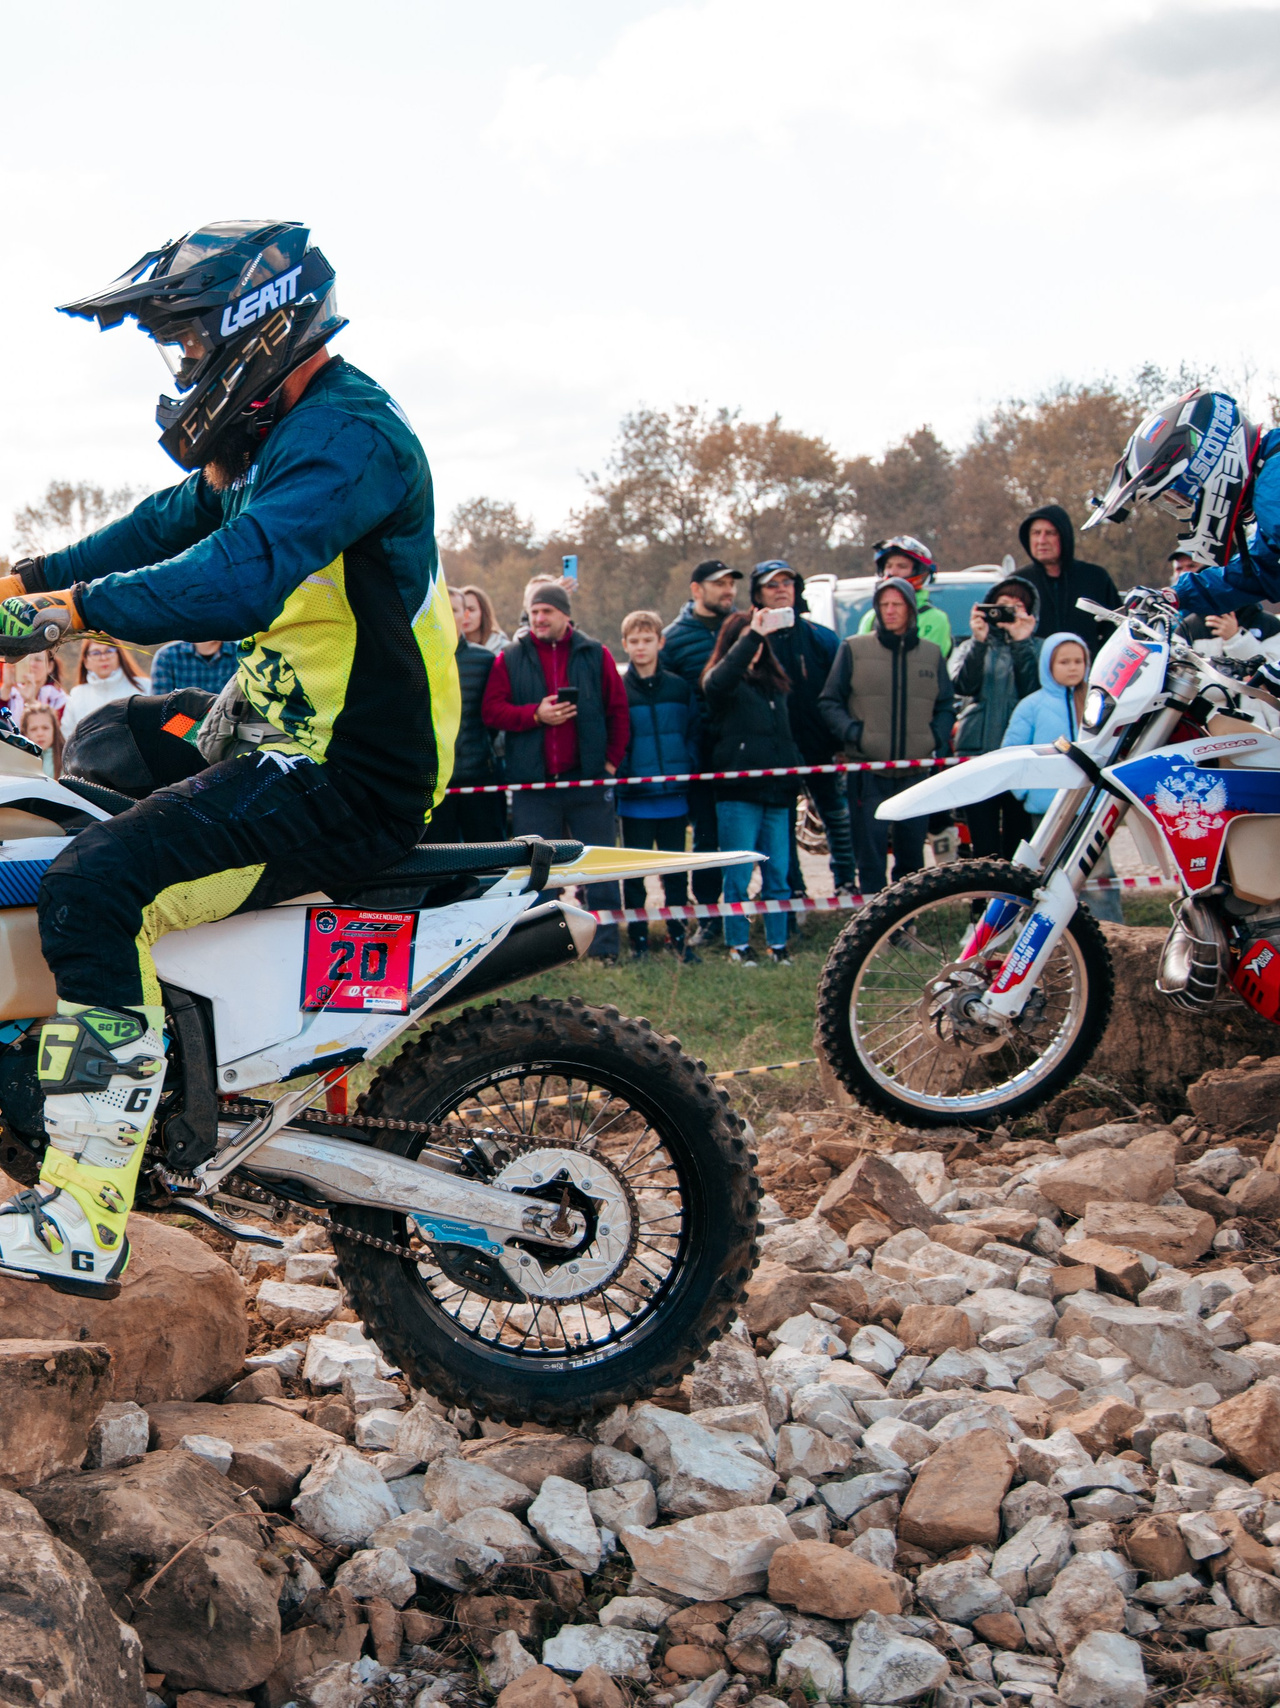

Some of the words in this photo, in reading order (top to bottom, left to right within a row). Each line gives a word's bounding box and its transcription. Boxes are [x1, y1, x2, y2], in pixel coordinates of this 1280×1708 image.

[220, 265, 302, 337] LEATT
[1193, 739, 1258, 755] GASGAS
[340, 921, 406, 932] BSE
[328, 940, 389, 982] 20
[997, 952, 1021, 990] ENDURO
[1016, 921, 1039, 954] LEGION
[1013, 945, 1036, 976] SOCHI
[38, 1024, 80, 1081] G
[490, 1066, 526, 1080] EXCEL
[124, 1088, 152, 1112] G
[72, 1250, 94, 1271] G
